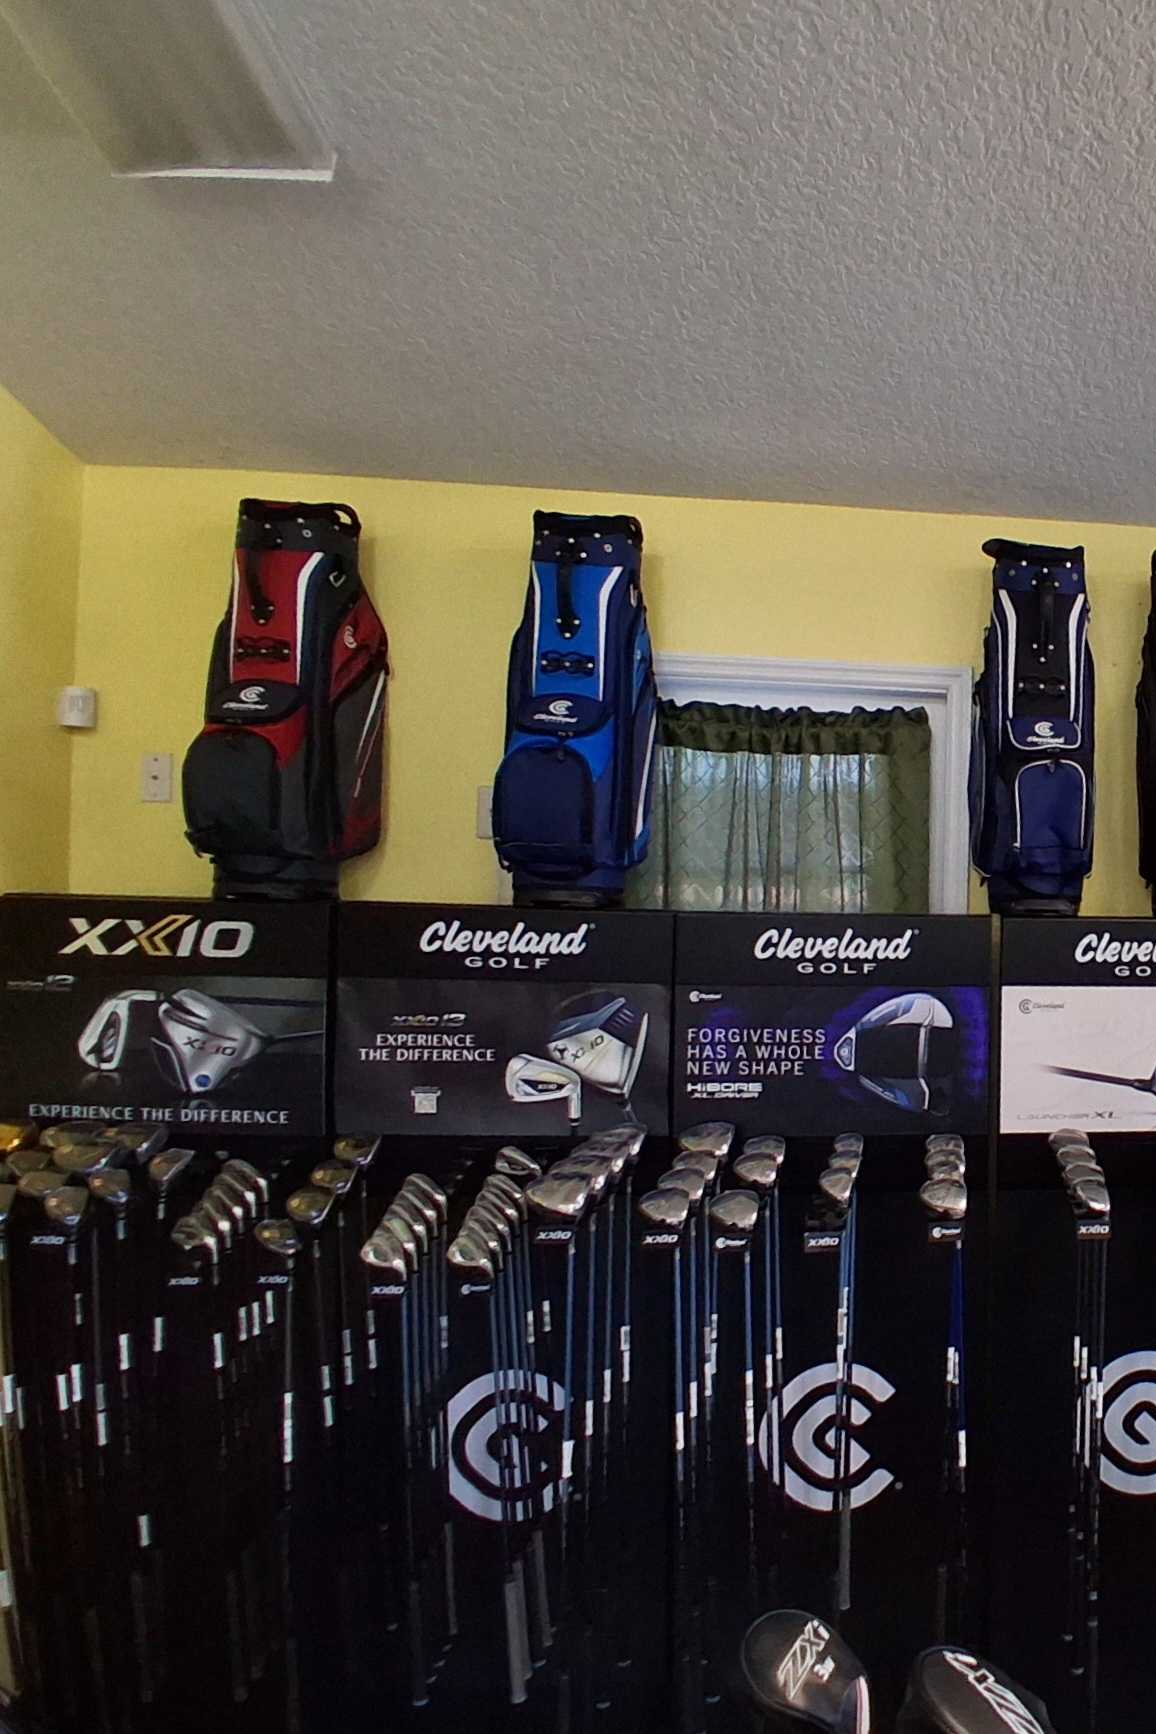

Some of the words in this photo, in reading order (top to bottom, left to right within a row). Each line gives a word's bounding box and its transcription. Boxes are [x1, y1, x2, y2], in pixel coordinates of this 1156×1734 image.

[58, 914, 255, 958] XXIO
[419, 920, 588, 955] Cleveland
[754, 927, 912, 960] Cleveland
[464, 956, 551, 970] GOLF
[796, 962, 878, 975] GOLF
[376, 1033, 476, 1047] EXPERIENCE
[687, 1027, 827, 1043] FORGIVENESS
[359, 1048, 391, 1062] THE
[395, 1048, 497, 1062] DIFFERENCE
[686, 1044, 728, 1059] HAS
[734, 1044, 748, 1059] A
[755, 1044, 826, 1060] WHOLE
[686, 1060, 731, 1076] NEW
[737, 1060, 805, 1076] SHAPE
[28, 1103, 134, 1121] EXPERIENCE
[140, 1107, 174, 1121] THE
[180, 1108, 289, 1124] DIFFERENCE
